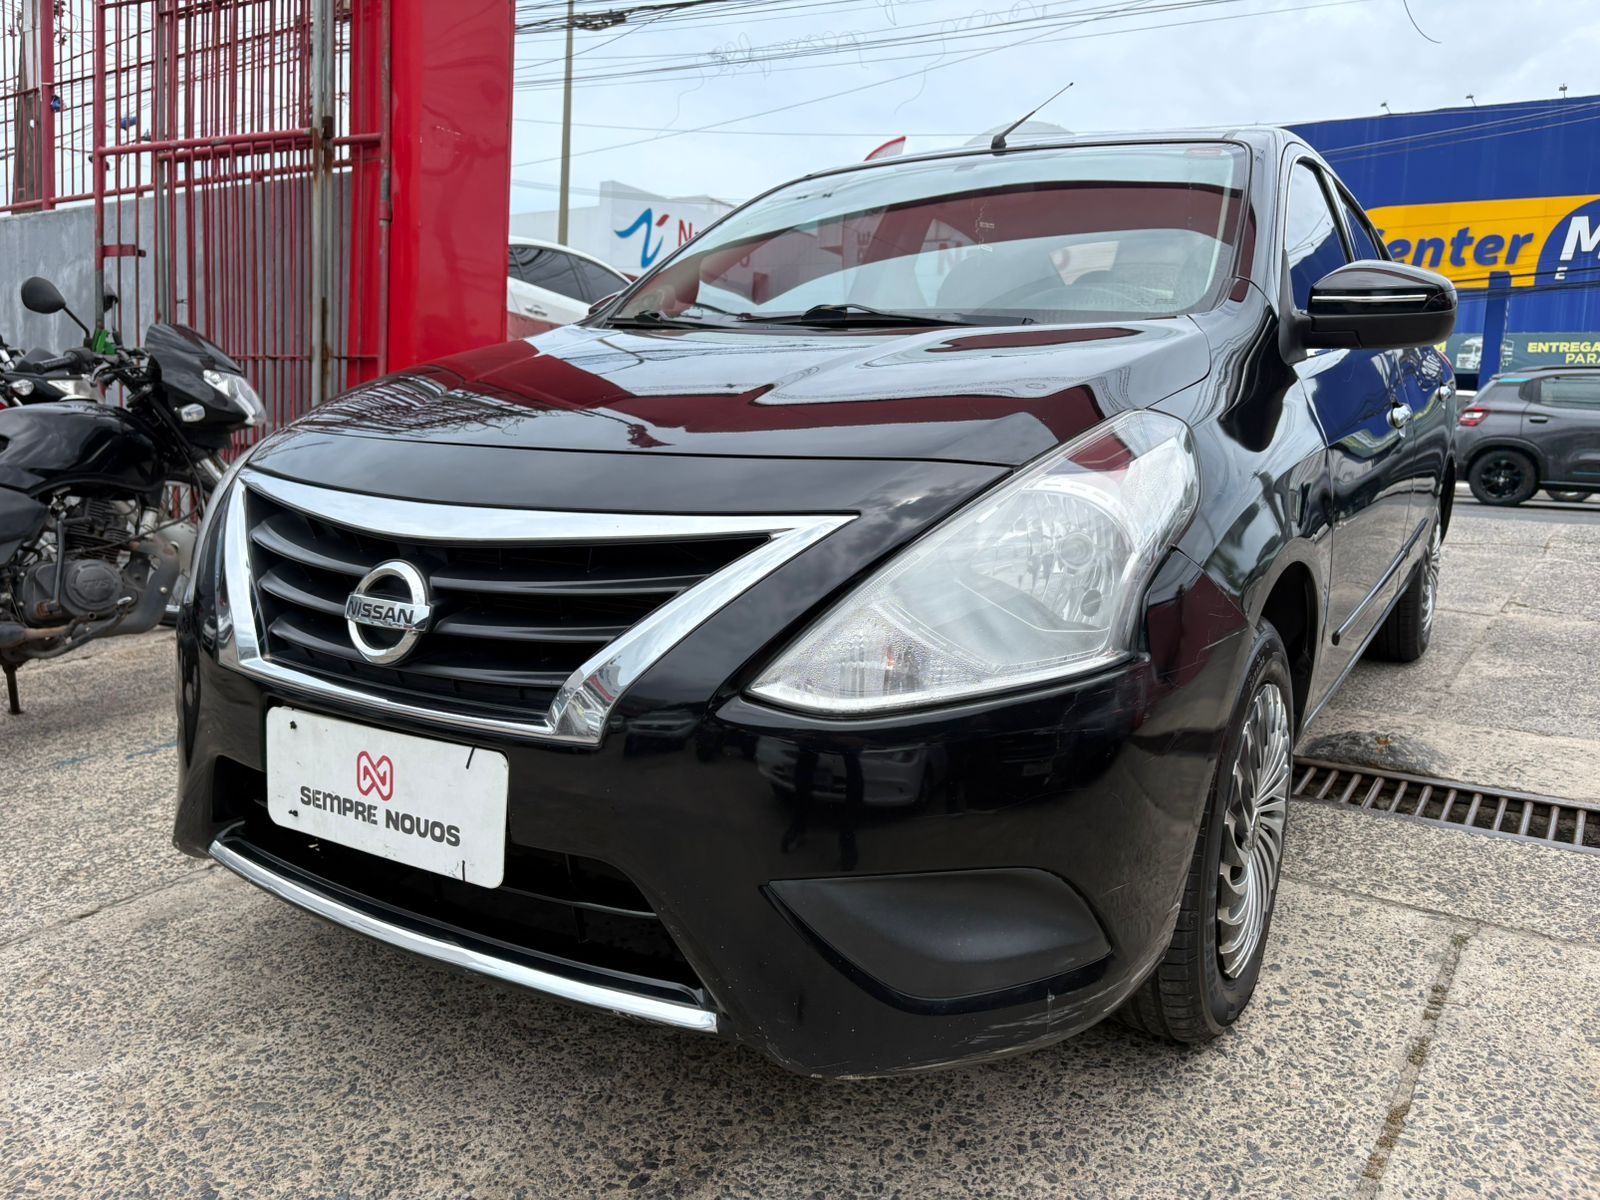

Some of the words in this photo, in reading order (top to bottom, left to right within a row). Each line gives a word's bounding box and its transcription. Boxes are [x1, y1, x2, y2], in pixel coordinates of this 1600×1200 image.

[1376, 227, 1534, 268] enter
[1565, 353, 1600, 365] PAR
[346, 600, 414, 624] NISSAN
[300, 785, 378, 825] SEMPRE
[385, 808, 461, 847] NOVOS
